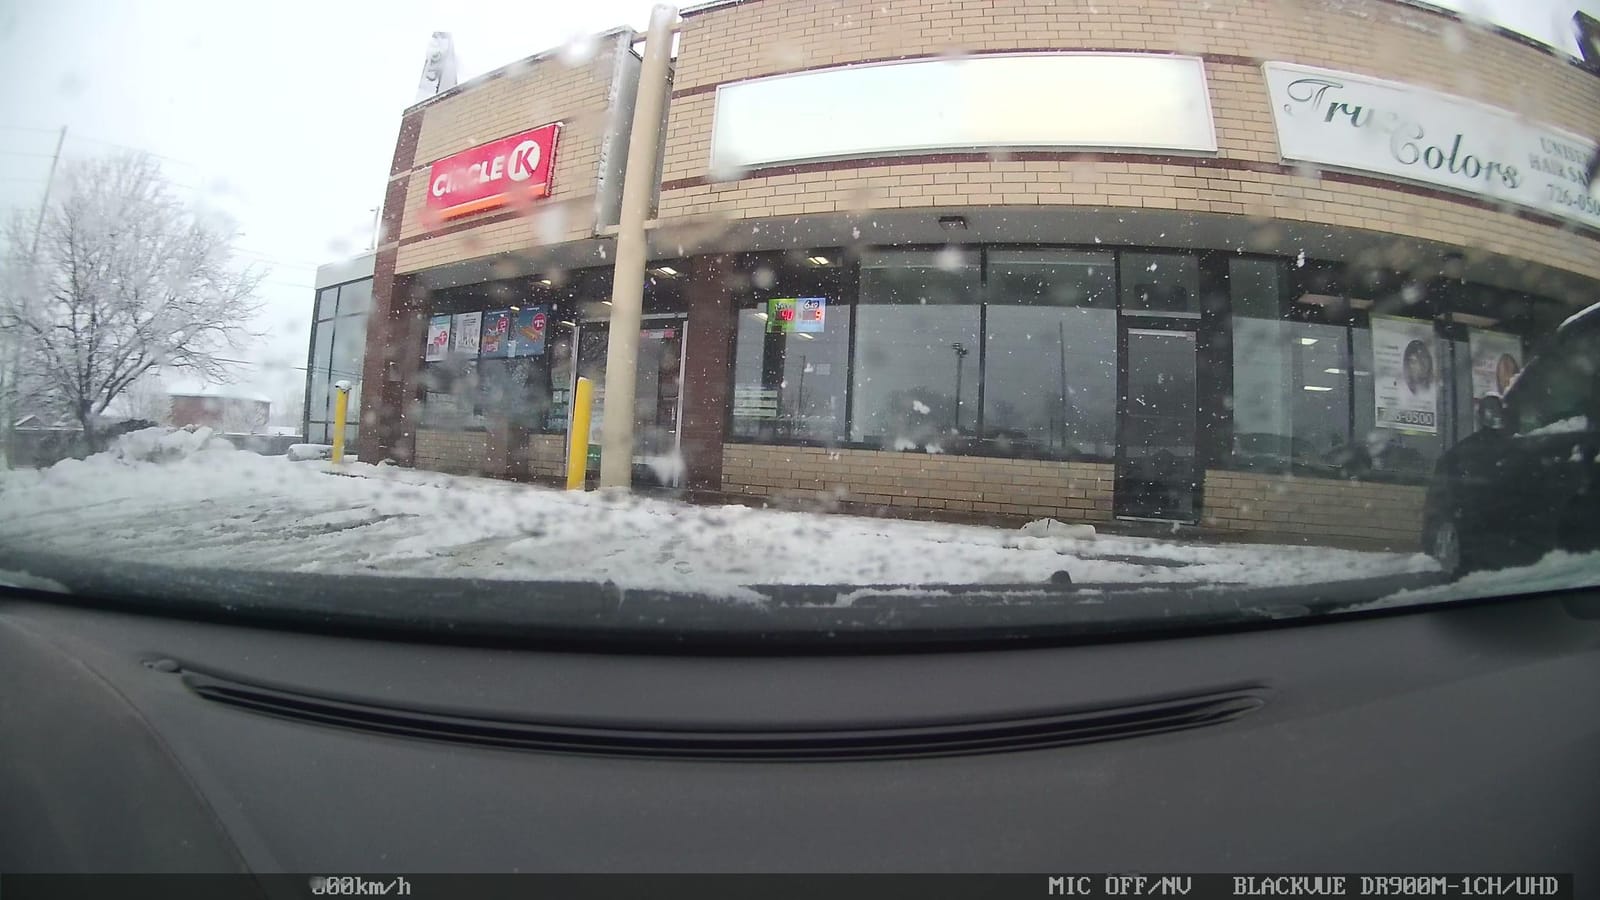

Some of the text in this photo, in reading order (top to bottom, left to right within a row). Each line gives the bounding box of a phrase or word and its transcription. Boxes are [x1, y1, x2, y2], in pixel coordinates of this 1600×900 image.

[1283, 78, 1521, 189] Tru Colors
[432, 155, 505, 197] CICLE
[1380, 409, 1433, 426] 6-0500
